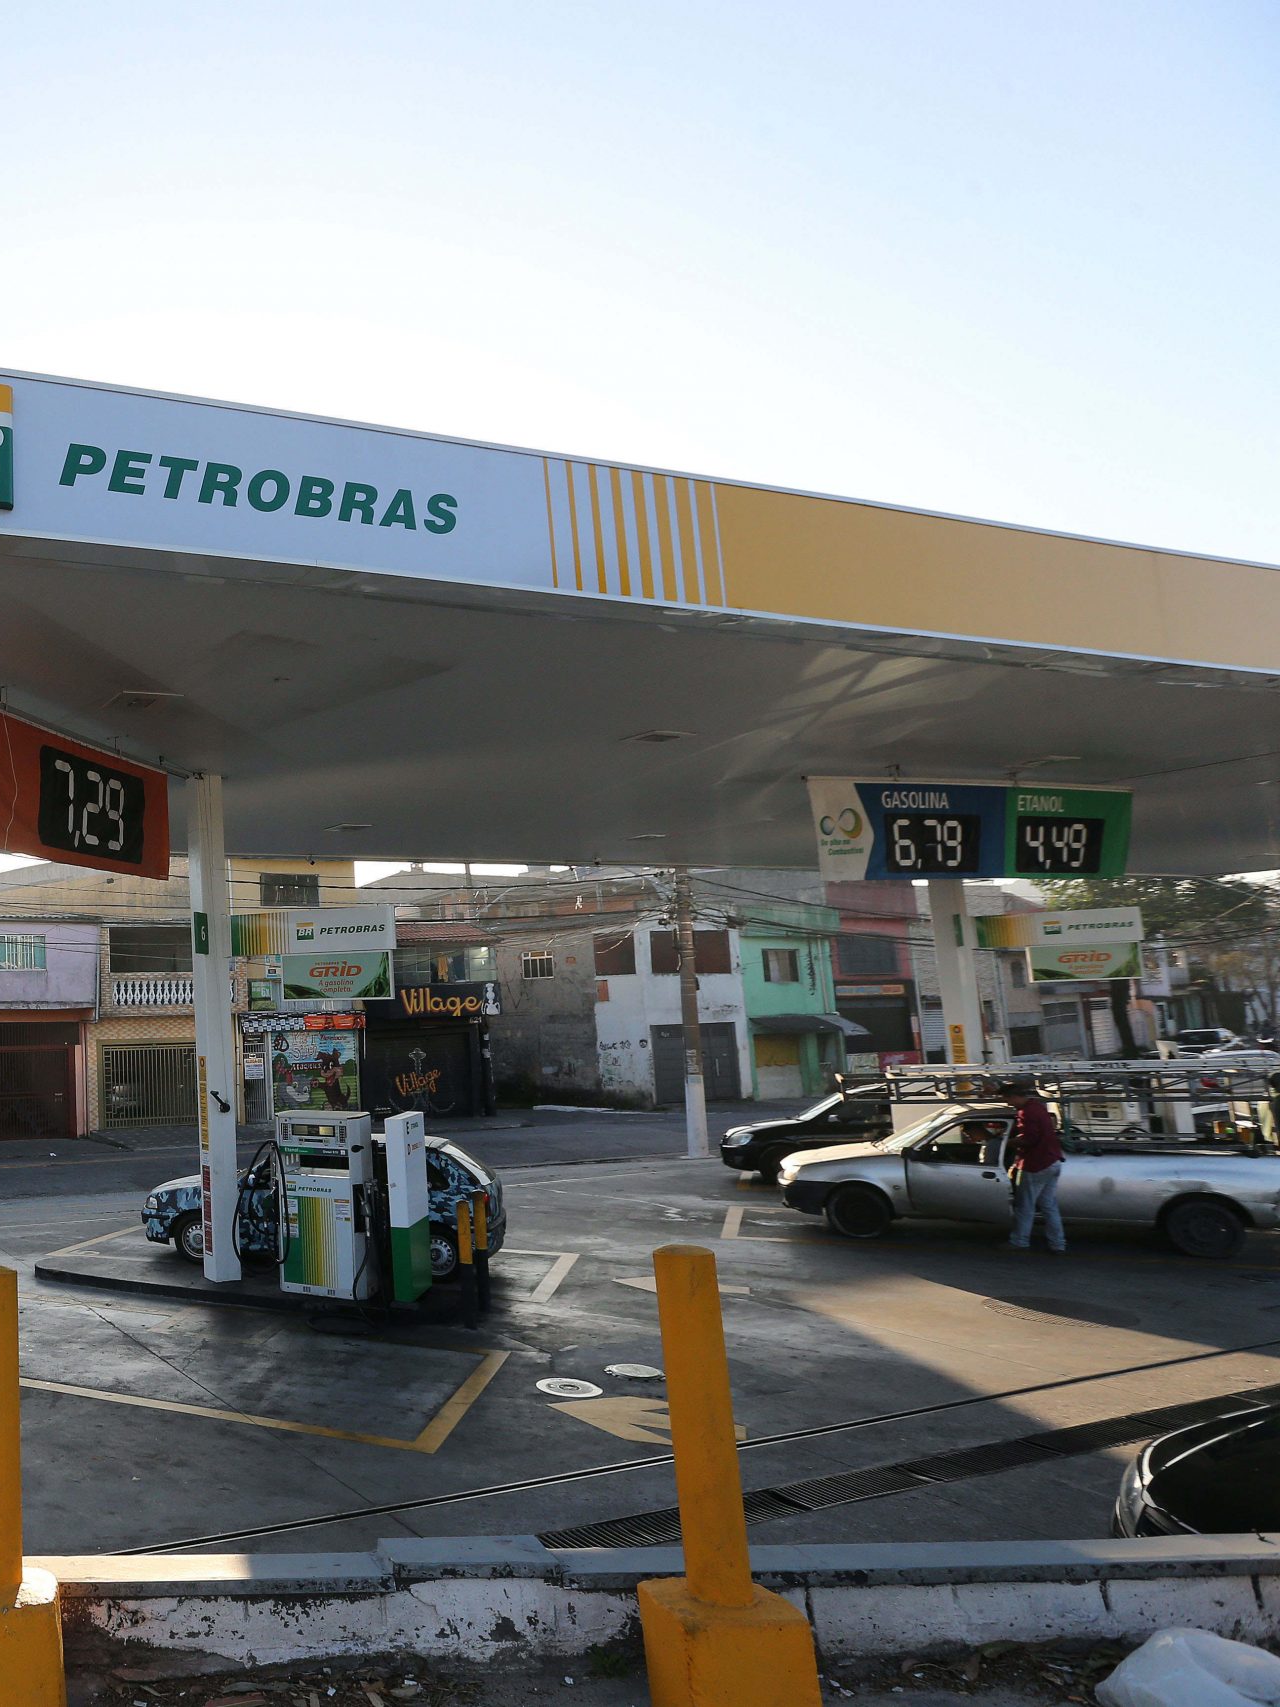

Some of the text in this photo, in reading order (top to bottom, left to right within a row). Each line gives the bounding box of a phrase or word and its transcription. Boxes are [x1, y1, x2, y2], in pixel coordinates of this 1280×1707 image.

[58, 443, 460, 536] PETROBRAS
[881, 791, 950, 809] GASOLINA
[1017, 794, 1065, 812] ETANOL
[893, 819, 962, 869] 6,79
[1026, 823, 1087, 870] 4,49
[298, 924, 385, 936] BR PETROBRAS
[1067, 921, 1134, 931] PETROBRAS
[324, 979, 354, 988] gasolina
[401, 987, 482, 1016] Village
[395, 1069, 441, 1097] Village
